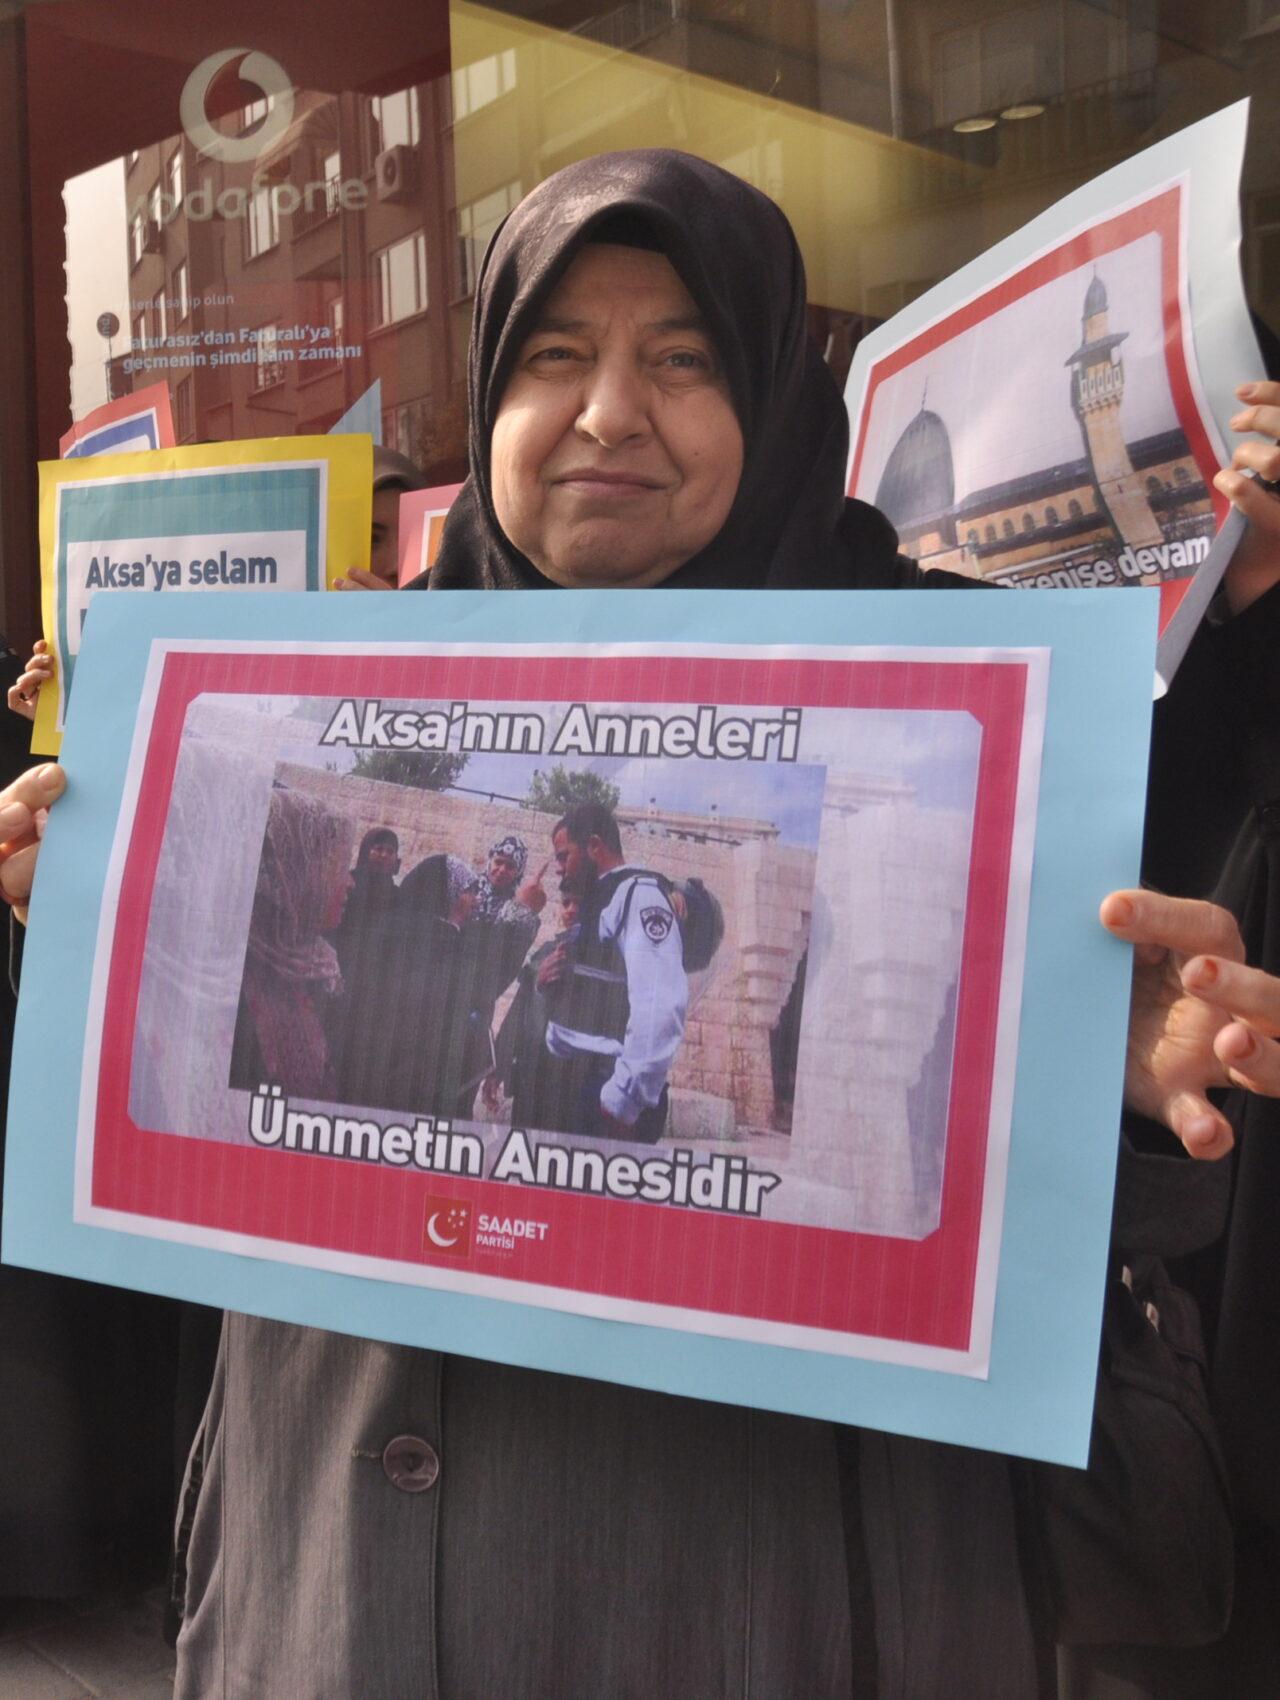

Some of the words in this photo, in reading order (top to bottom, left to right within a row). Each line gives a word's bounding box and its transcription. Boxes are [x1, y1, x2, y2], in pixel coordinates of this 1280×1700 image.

[126, 172, 370, 224] vodafone
[204, 294, 235, 305] olun
[123, 330, 236, 350] aturasız'dan
[123, 353, 206, 374] geçmenin
[210, 348, 257, 369] şimdi
[299, 345, 362, 361] zamanı
[85, 553, 181, 591] Aksa'ya
[188, 550, 277, 585] selam
[1120, 536, 1210, 576] devam
[320, 698, 544, 755] Aksa'nın
[549, 702, 803, 763] Anneleri
[249, 1083, 484, 1177] Ümmetin
[488, 1127, 782, 1216] Annesidir
[476, 1234, 515, 1250] PARTİSİ
[478, 1213, 549, 1241] SAADET
